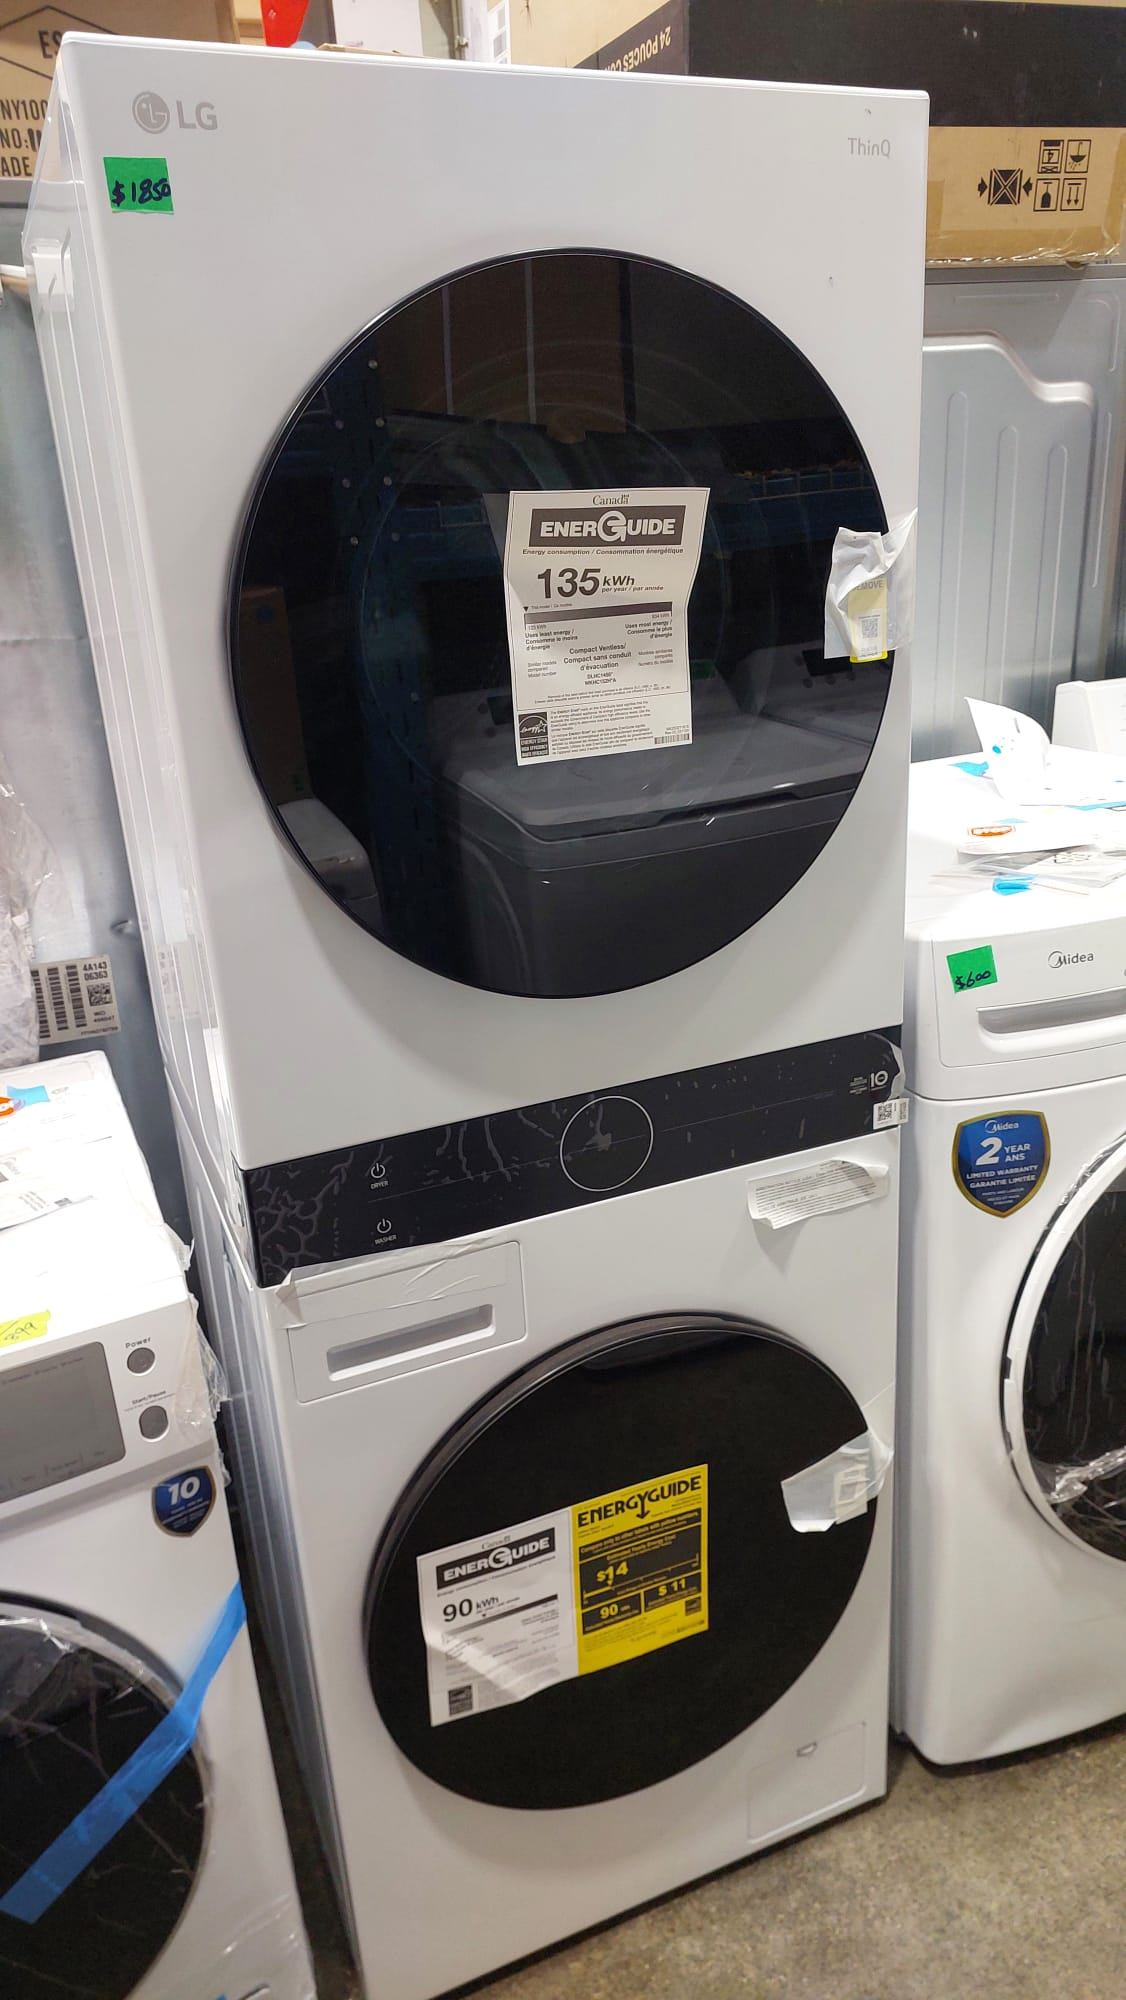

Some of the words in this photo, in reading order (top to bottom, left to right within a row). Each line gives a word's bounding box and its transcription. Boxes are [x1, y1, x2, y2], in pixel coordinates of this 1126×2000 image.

[660, 26, 671, 50] 24
[623, 34, 658, 72] POUCES
[176, 100, 218, 131] LG
[848, 137, 892, 158] ThinQ
[1, 156, 33, 177] ADE
[592, 494, 630, 506] Canada
[540, 511, 676, 542] ENERGUIDE
[522, 548, 546, 556] Energy
[646, 547, 684, 555] énergétique
[537, 567, 601, 599] 135
[602, 575, 635, 587] kWh
[563, 655, 592, 665] Compact
[609, 651, 632, 660] conduit
[569, 646, 598, 655] Compact
[1048, 951, 1094, 969] Midea
[871, 1070, 888, 1087] 10
[985, 1120, 1019, 1133] Midea
[975, 1136, 1003, 1166] 2
[1004, 1143, 1031, 1154] YEAR
[1005, 1153, 1026, 1162] ANS
[966, 1170, 995, 1179] LIMITED
[997, 1165, 1039, 1176] WARRANTY
[125, 1337, 152, 1349] Power
[168, 1476, 200, 1506] 10
[577, 1475, 702, 1528] ENERGYGUIDE
[443, 1536, 550, 1582] ENERGUIDE
[443, 1598, 473, 1623] 90
[600, 1603, 619, 1619] 90
